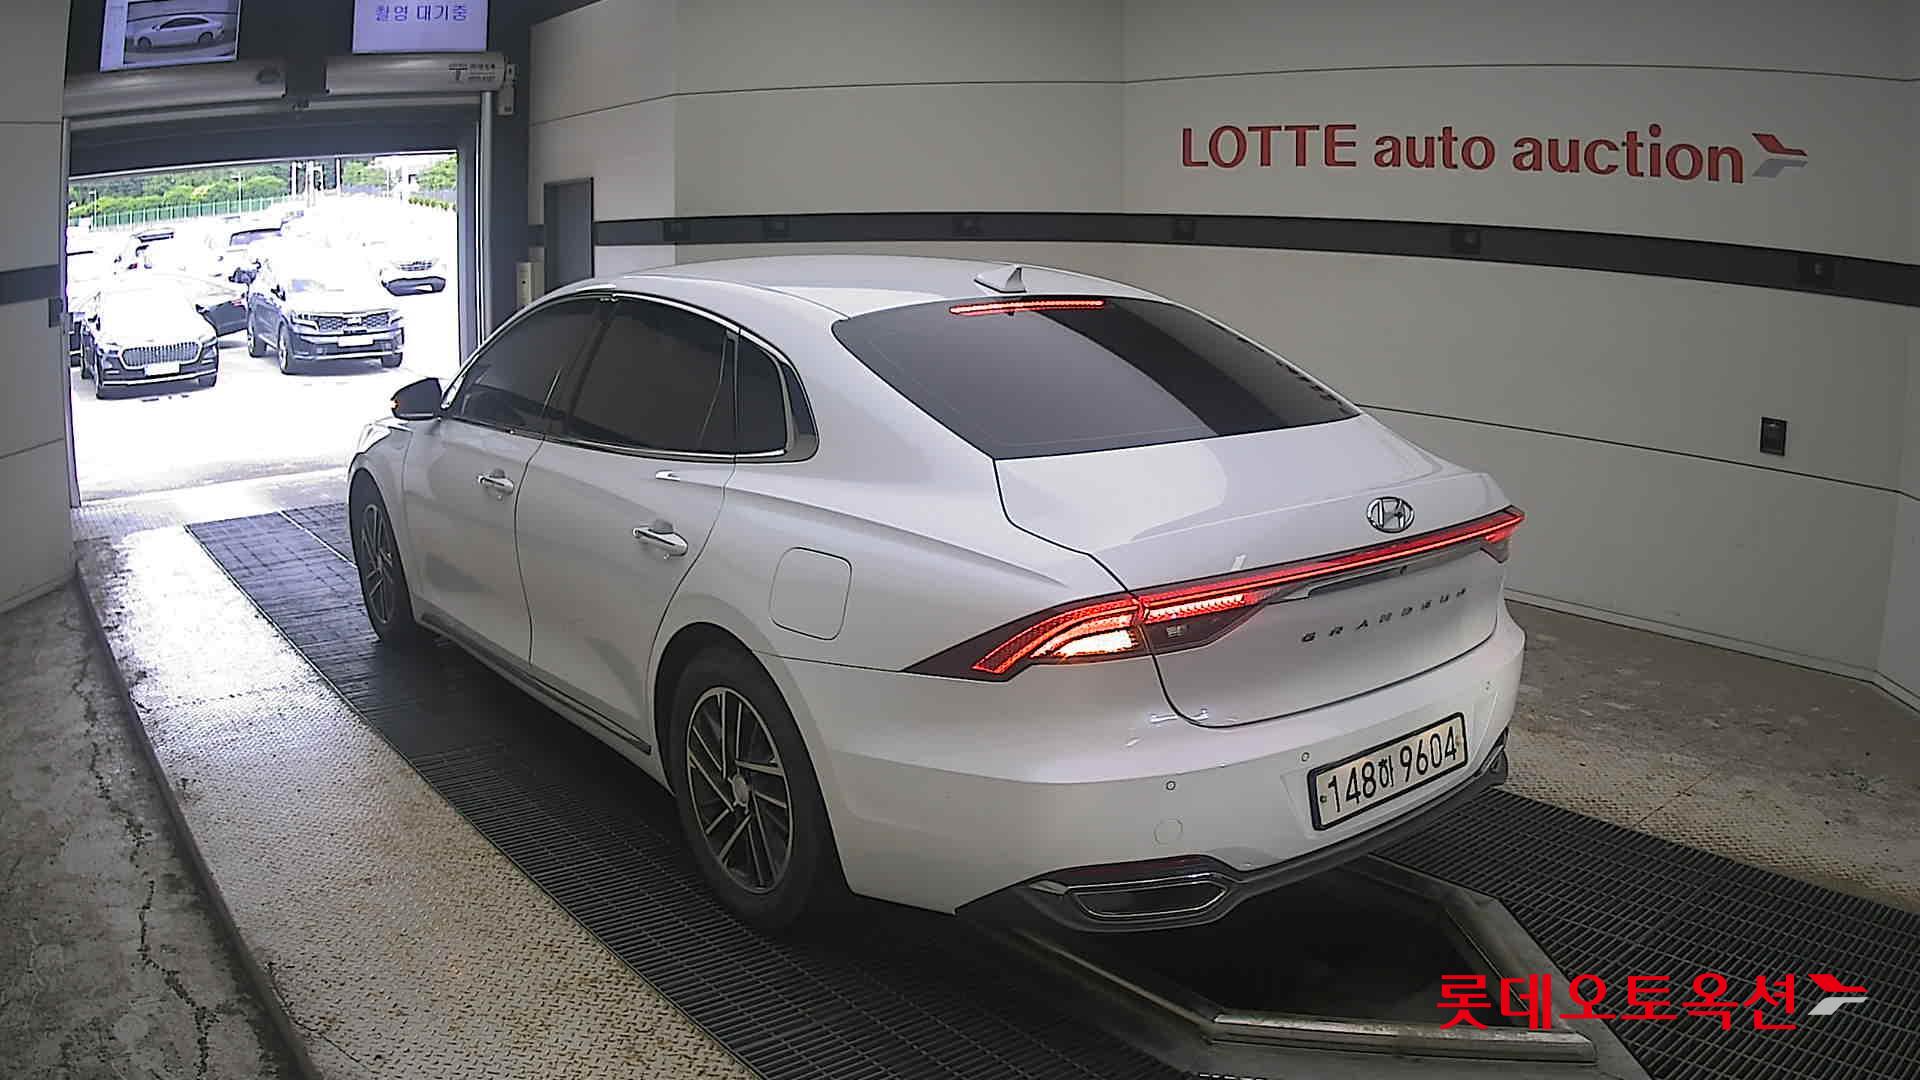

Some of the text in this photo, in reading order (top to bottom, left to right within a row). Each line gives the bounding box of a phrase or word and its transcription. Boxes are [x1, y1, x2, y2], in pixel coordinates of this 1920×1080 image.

[416, 5, 467, 21] 대기중
[1181, 123, 1745, 184] LOTTE auto auction
[1399, 726, 1458, 783] 9604
